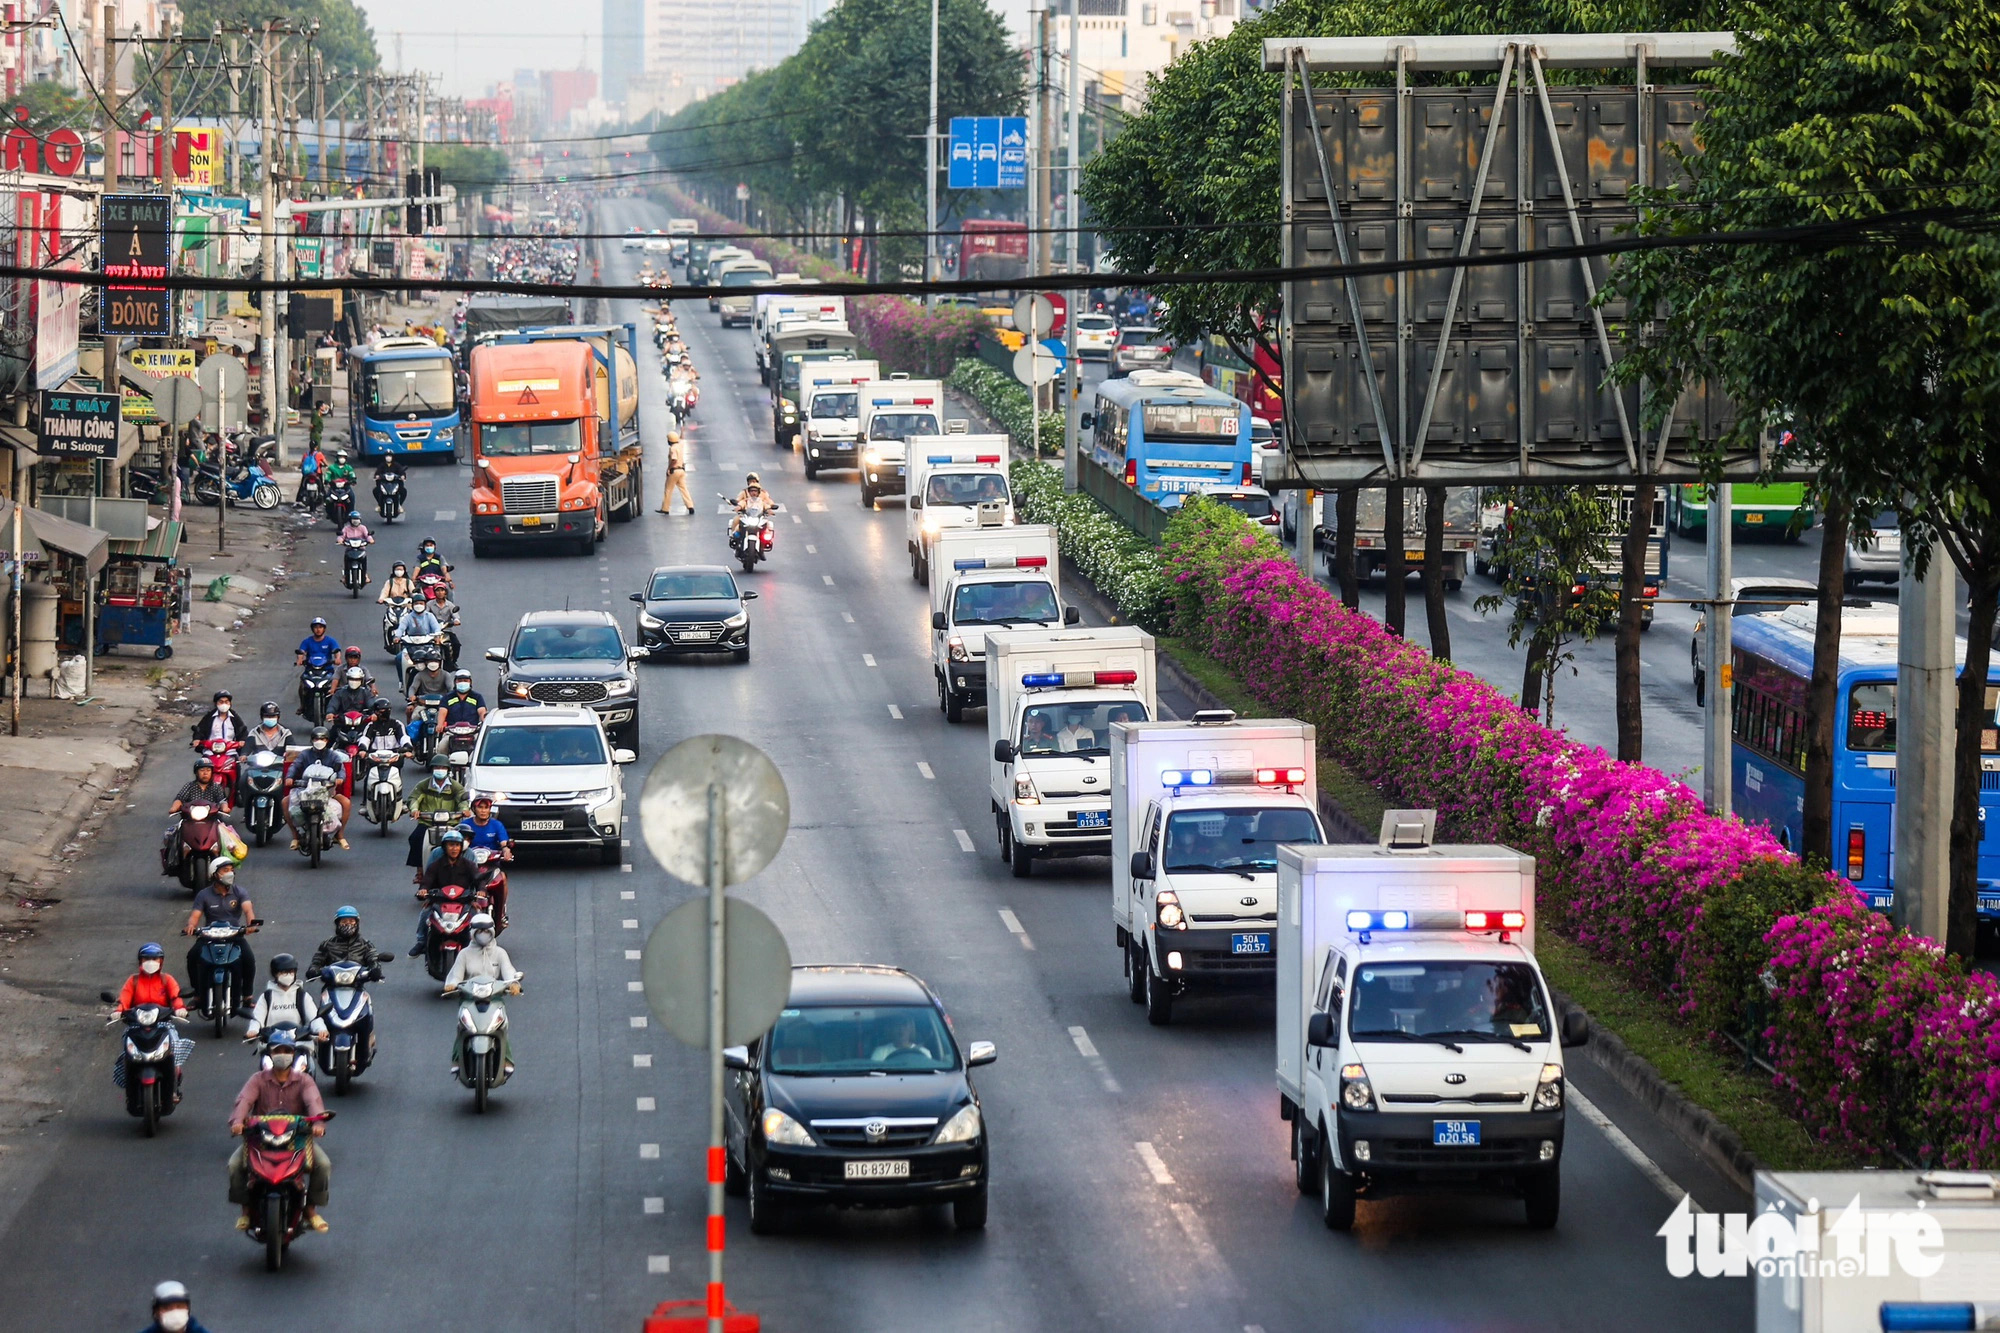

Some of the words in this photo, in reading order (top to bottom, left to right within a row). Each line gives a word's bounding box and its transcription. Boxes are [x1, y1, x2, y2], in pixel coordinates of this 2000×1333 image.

[109, 205, 126, 221] XE
[132, 202, 163, 222] MÁY
[129, 224, 142, 256] Á
[111, 294, 160, 326] ĐÔNG
[148, 354, 158, 367] XE
[160, 351, 177, 367] MÁY
[50, 398, 71, 411] XE
[75, 397, 110, 413] MÁY
[44, 413, 82, 437] THÀNH
[84, 415, 115, 440] CÔNG
[1223, 419, 1238, 434] 151
[52, 440, 67, 450] An
[71, 440, 105, 454] Sương
[1085, 811, 1099, 819] 50A
[1080, 818, 1105, 827] 019.95
[1874, 896, 1886, 907] XIN
[1242, 934, 1259, 944] 50A
[1236, 943, 1266, 952] 020.57
[1447, 1122, 1467, 1133] 50A
[1439, 1132, 1475, 1143] 020.56
[847, 1162, 908, 1177] 51G-837.86
